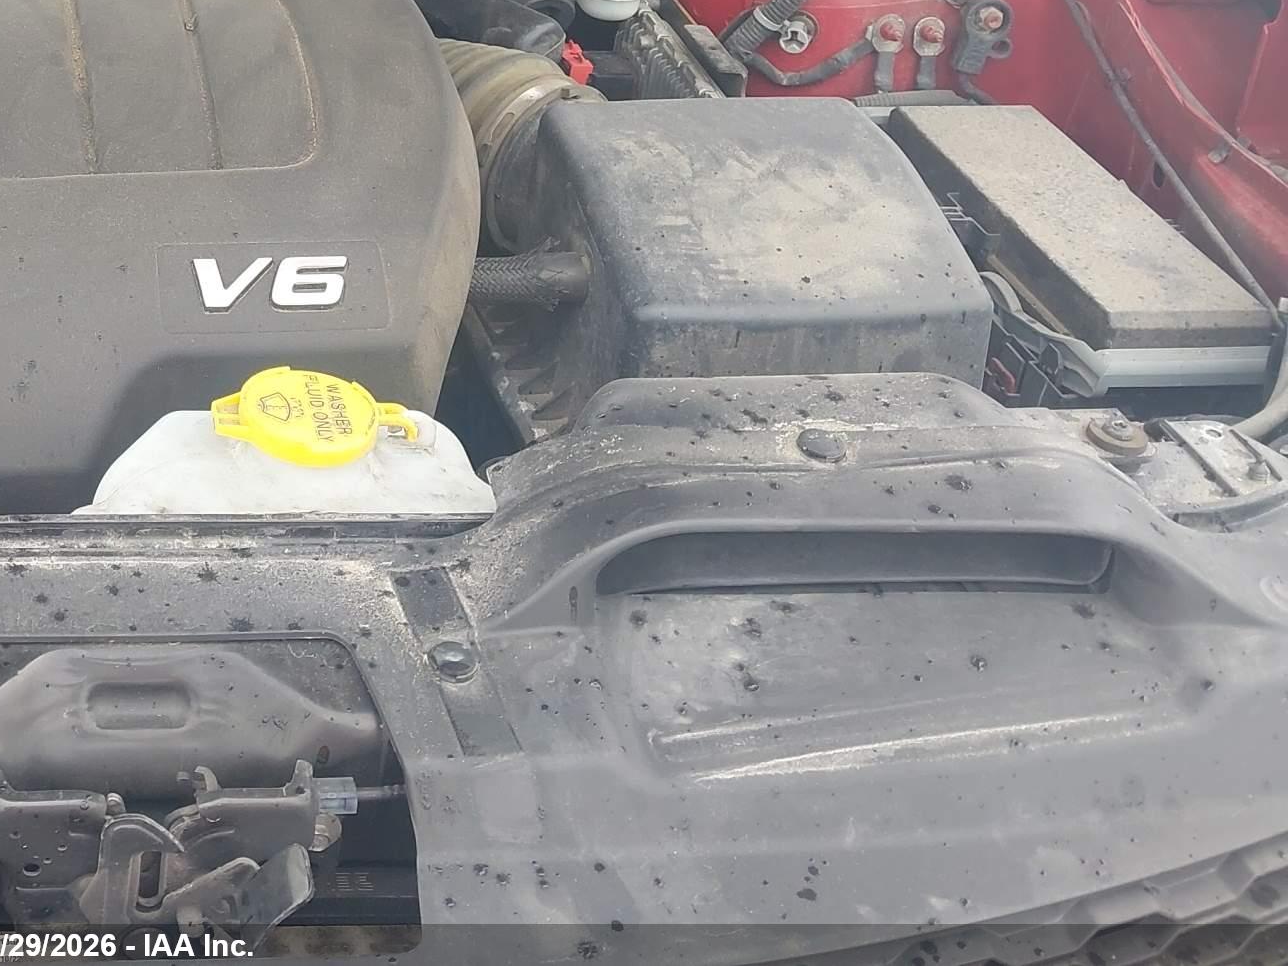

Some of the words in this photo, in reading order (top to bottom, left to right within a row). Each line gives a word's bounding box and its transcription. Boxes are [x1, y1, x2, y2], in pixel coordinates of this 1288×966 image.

[192, 255, 348, 312] V6
[303, 374, 324, 412] FLUID
[326, 384, 353, 435] WASHER
[313, 411, 335, 443] ONLY
